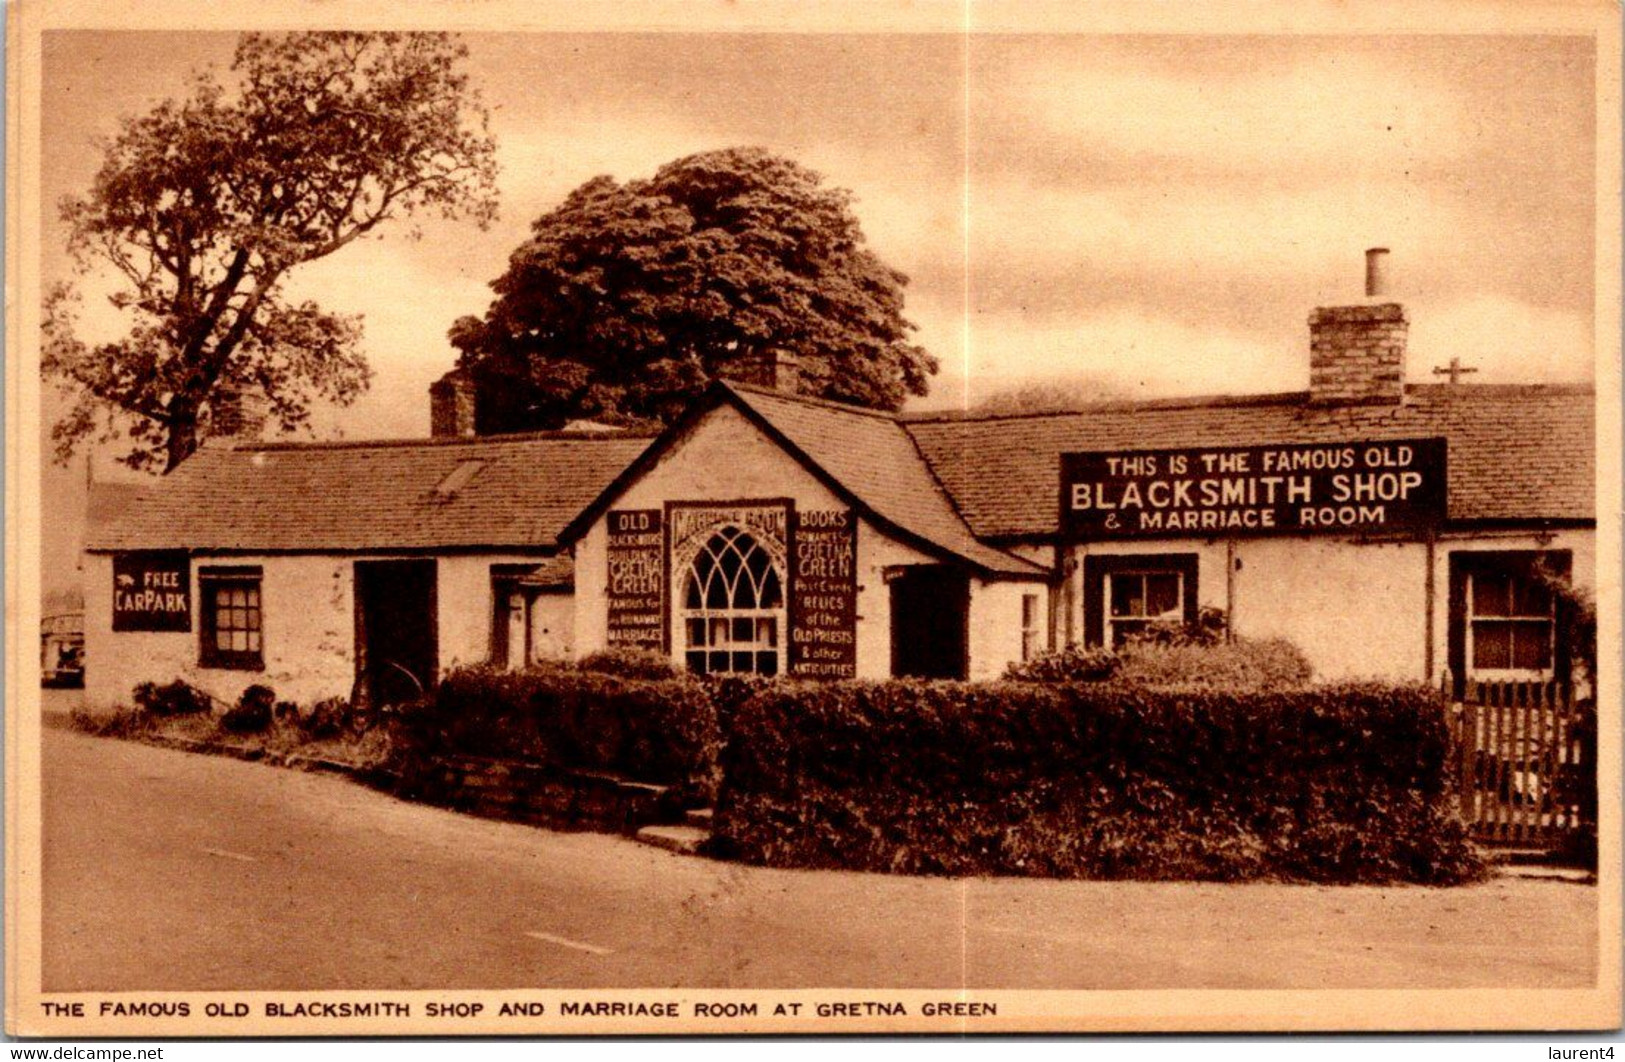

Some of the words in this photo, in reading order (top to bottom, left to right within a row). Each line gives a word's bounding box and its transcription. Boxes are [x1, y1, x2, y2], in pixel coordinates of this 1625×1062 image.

[1106, 456, 1157, 476] THIS
[1169, 454, 1189, 475] IS
[1201, 452, 1251, 473] THE
[1263, 447, 1356, 472] FAMOUS
[1364, 446, 1413, 468] OLD
[1071, 475, 1312, 510] BLACKSMITH
[1332, 472, 1423, 502] SHOP
[619, 513, 649, 531] OLD
[800, 511, 848, 528] BOOKS
[1104, 512, 1121, 529] &
[1300, 505, 1385, 526] ROOM
[144, 572, 179, 587] FREE
